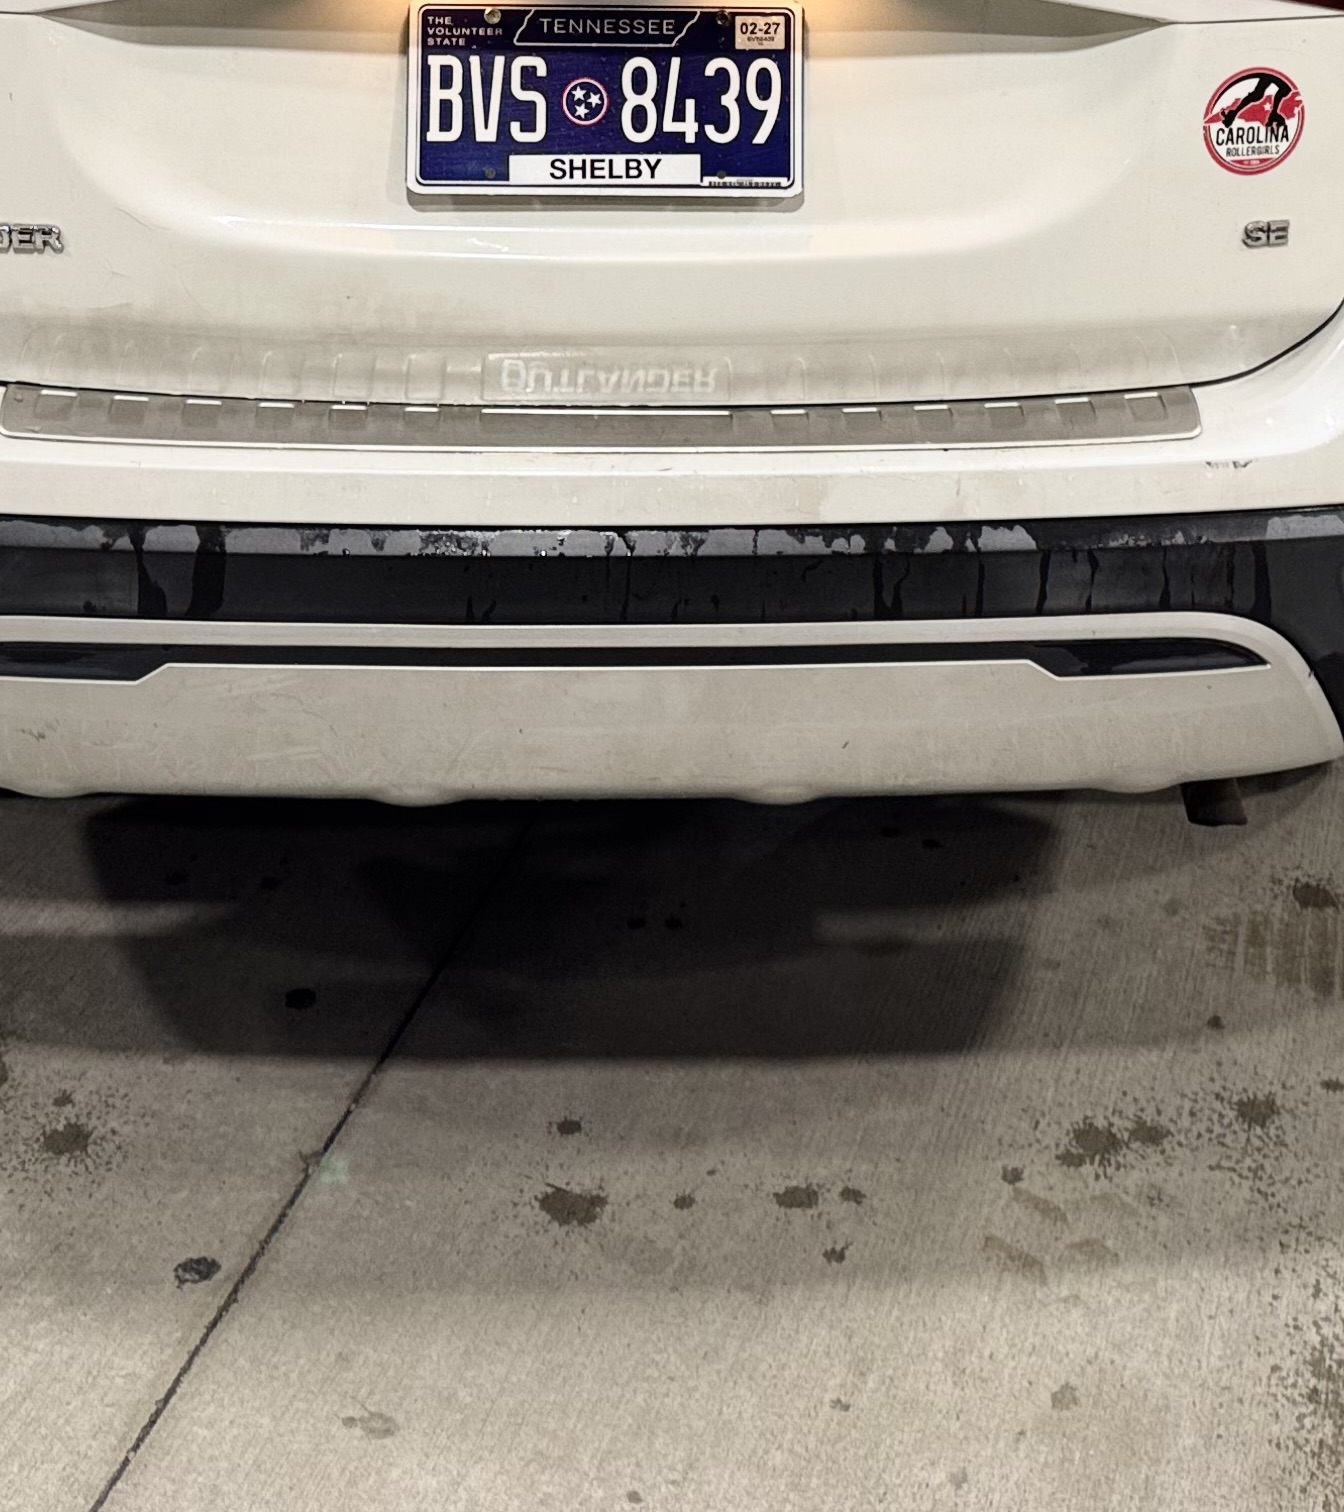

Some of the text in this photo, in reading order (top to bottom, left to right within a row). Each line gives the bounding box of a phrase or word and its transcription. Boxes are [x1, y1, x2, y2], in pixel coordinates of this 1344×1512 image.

[426, 16, 453, 26] THE
[539, 17, 676, 35] TENNESSEE
[739, 21, 781, 35] 02-27
[426, 27, 504, 37] VOLUNTEER
[426, 37, 467, 47] STATE
[425, 54, 783, 145] BVS 8439
[1216, 124, 1290, 147] CAROLINA
[548, 158, 663, 181] SHELBY
[1242, 219, 1291, 249] SE
